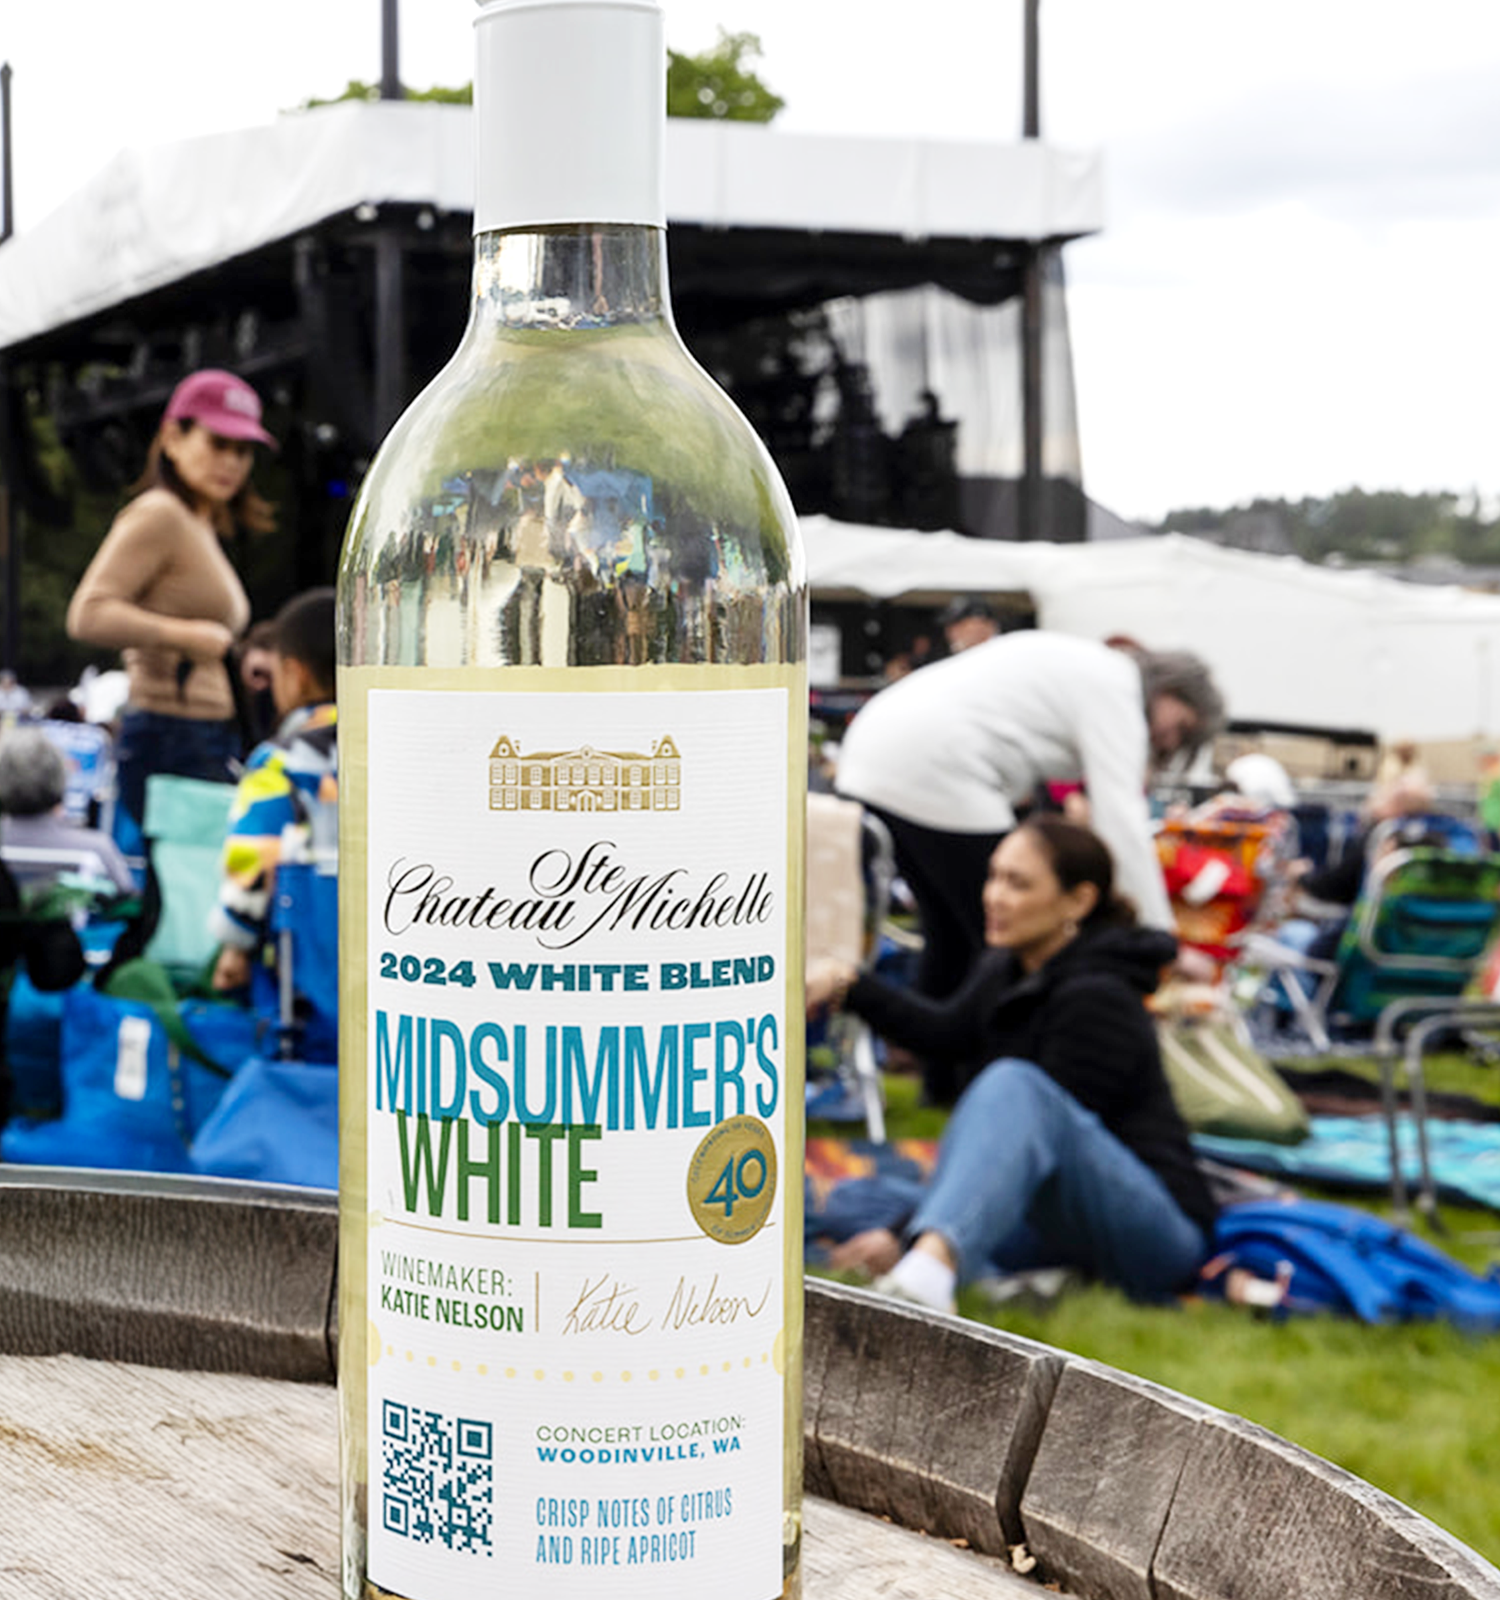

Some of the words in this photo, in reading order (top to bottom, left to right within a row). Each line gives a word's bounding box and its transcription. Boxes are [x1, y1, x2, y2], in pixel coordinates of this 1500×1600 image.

[529, 841, 625, 898] Ste
[384, 857, 576, 935] Chateau
[536, 869, 773, 950] Michelle
[380, 952, 476, 987] 2024
[487, 961, 649, 991] WHITE
[660, 954, 775, 990] BLEND
[376, 1010, 778, 1131] MIDSUMMER'S
[396, 1108, 602, 1229] WHITE
[703, 1148, 767, 1217] 40
[381, 1250, 513, 1297] WINEMAKER:
[381, 1284, 430, 1320] KATIE
[436, 1297, 523, 1332] NELSON
[562, 1273, 652, 1335] Katie
[536, 1425, 642, 1443] CONCERT
[650, 1415, 746, 1441] LOCATION:
[536, 1443, 705, 1464] WOODINVILLE,
[713, 1436, 741, 1454] WA
[536, 1497, 590, 1528] CRISP
[597, 1498, 650, 1528] NOTES
[656, 1496, 675, 1525] OF
[681, 1487, 732, 1523] CITRUS
[536, 1534, 573, 1565] AND
[581, 1536, 621, 1566] RIPE
[628, 1530, 696, 1565] APRICOT
